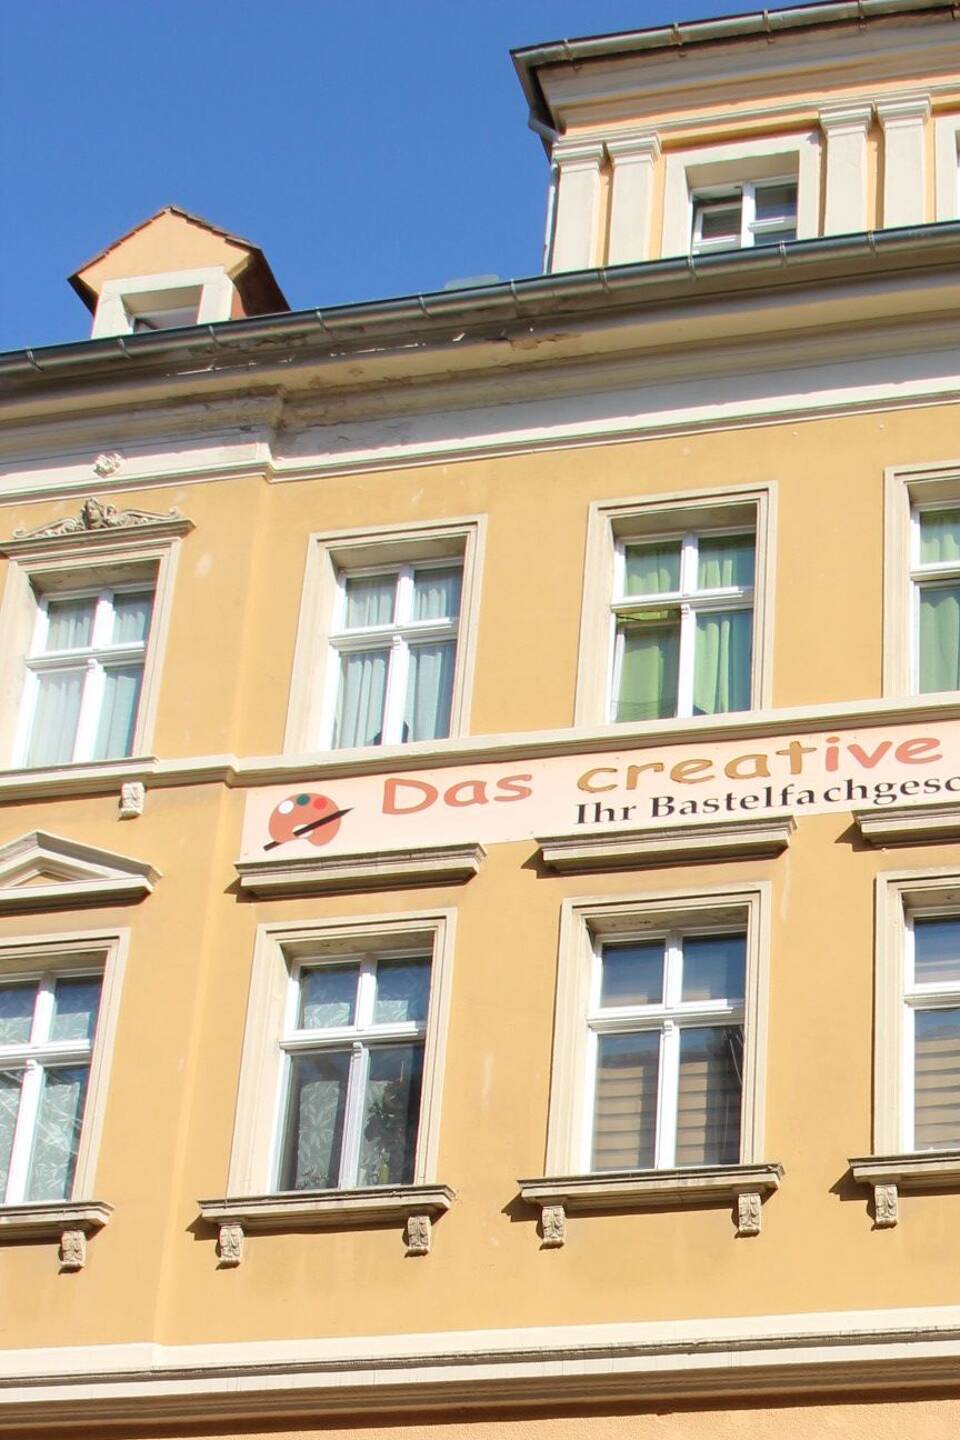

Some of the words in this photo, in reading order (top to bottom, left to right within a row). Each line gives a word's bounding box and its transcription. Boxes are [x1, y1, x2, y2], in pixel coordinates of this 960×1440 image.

[382, 774, 532, 815] Das
[576, 736, 943, 794] creative
[575, 799, 637, 824] Ihr
